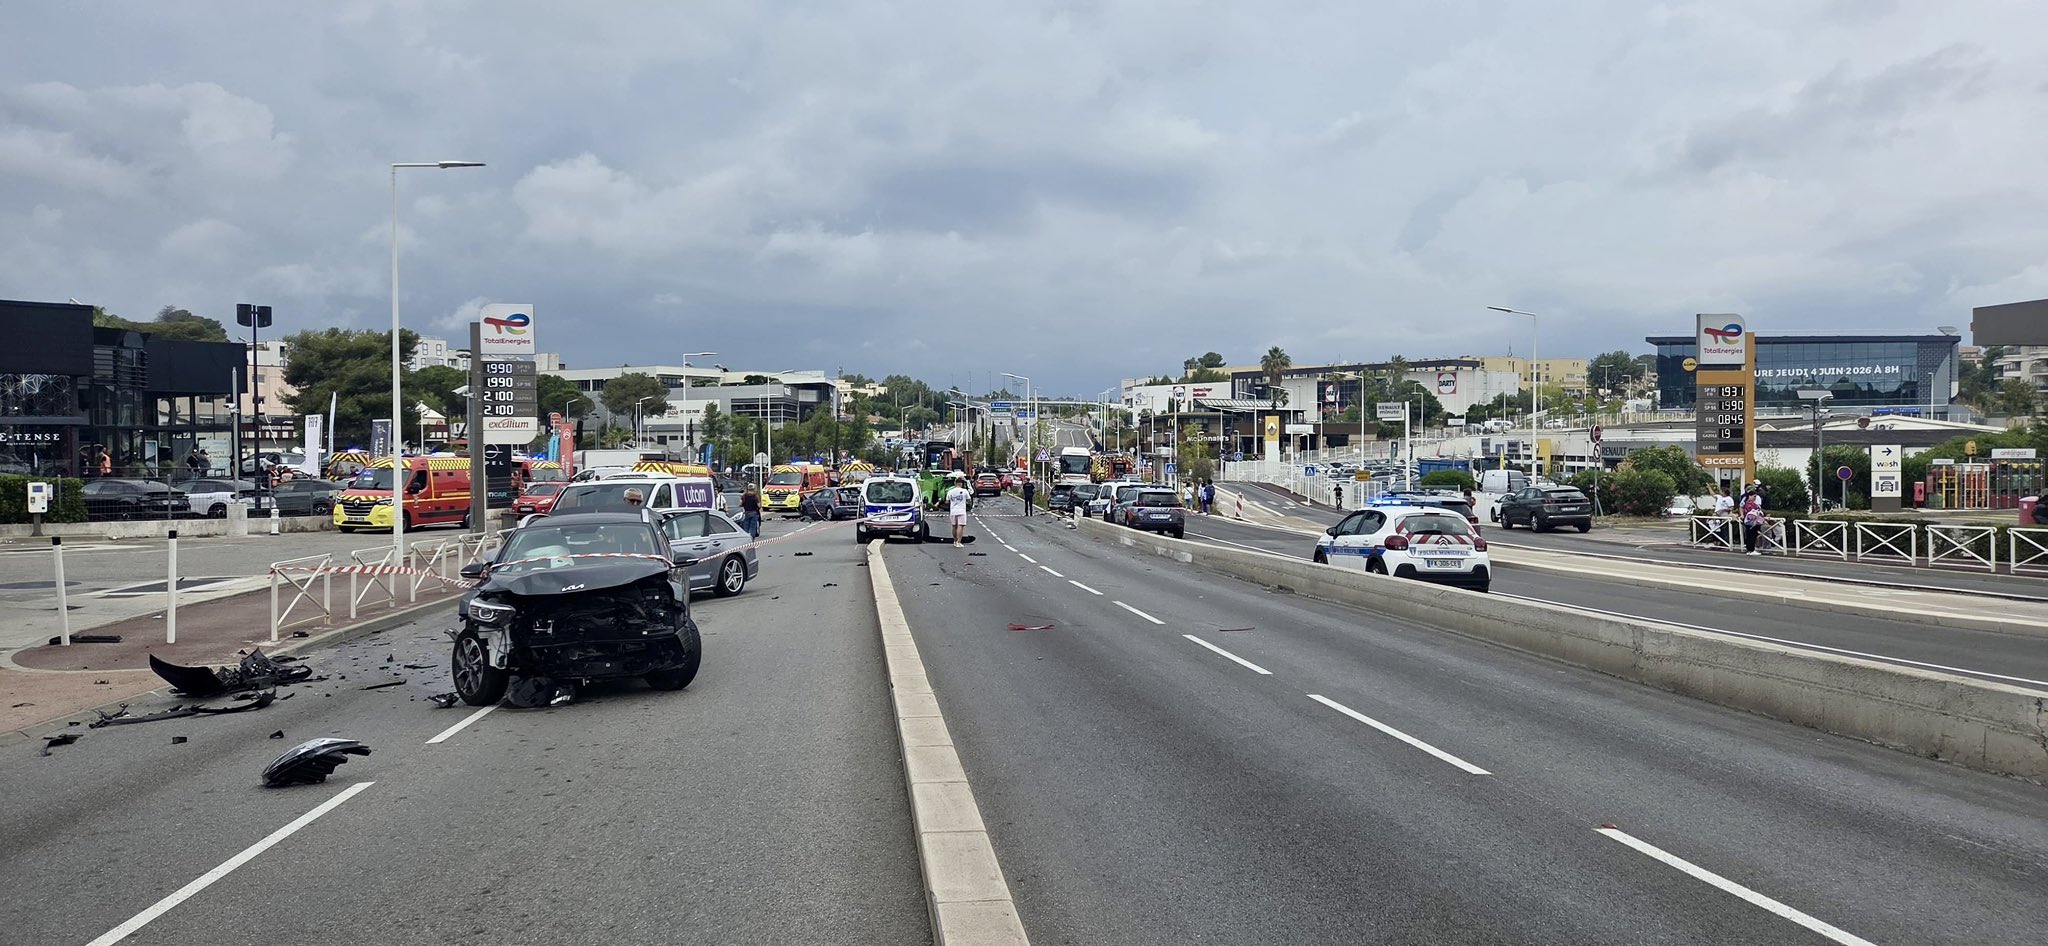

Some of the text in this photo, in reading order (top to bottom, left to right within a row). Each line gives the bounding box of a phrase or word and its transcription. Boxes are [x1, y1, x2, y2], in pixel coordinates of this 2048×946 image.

[1776, 368, 1808, 377] JEUDI
[1811, 367, 1817, 376] 4
[1819, 367, 1844, 376] JUIN
[1846, 366, 1872, 375] 2026
[1874, 364, 1882, 374] À
[1884, 365, 1899, 374] 8H
[489, 419, 529, 429] excellium
[1601, 446, 1628, 457] RENAULT
[1876, 460, 1899, 468] wash
